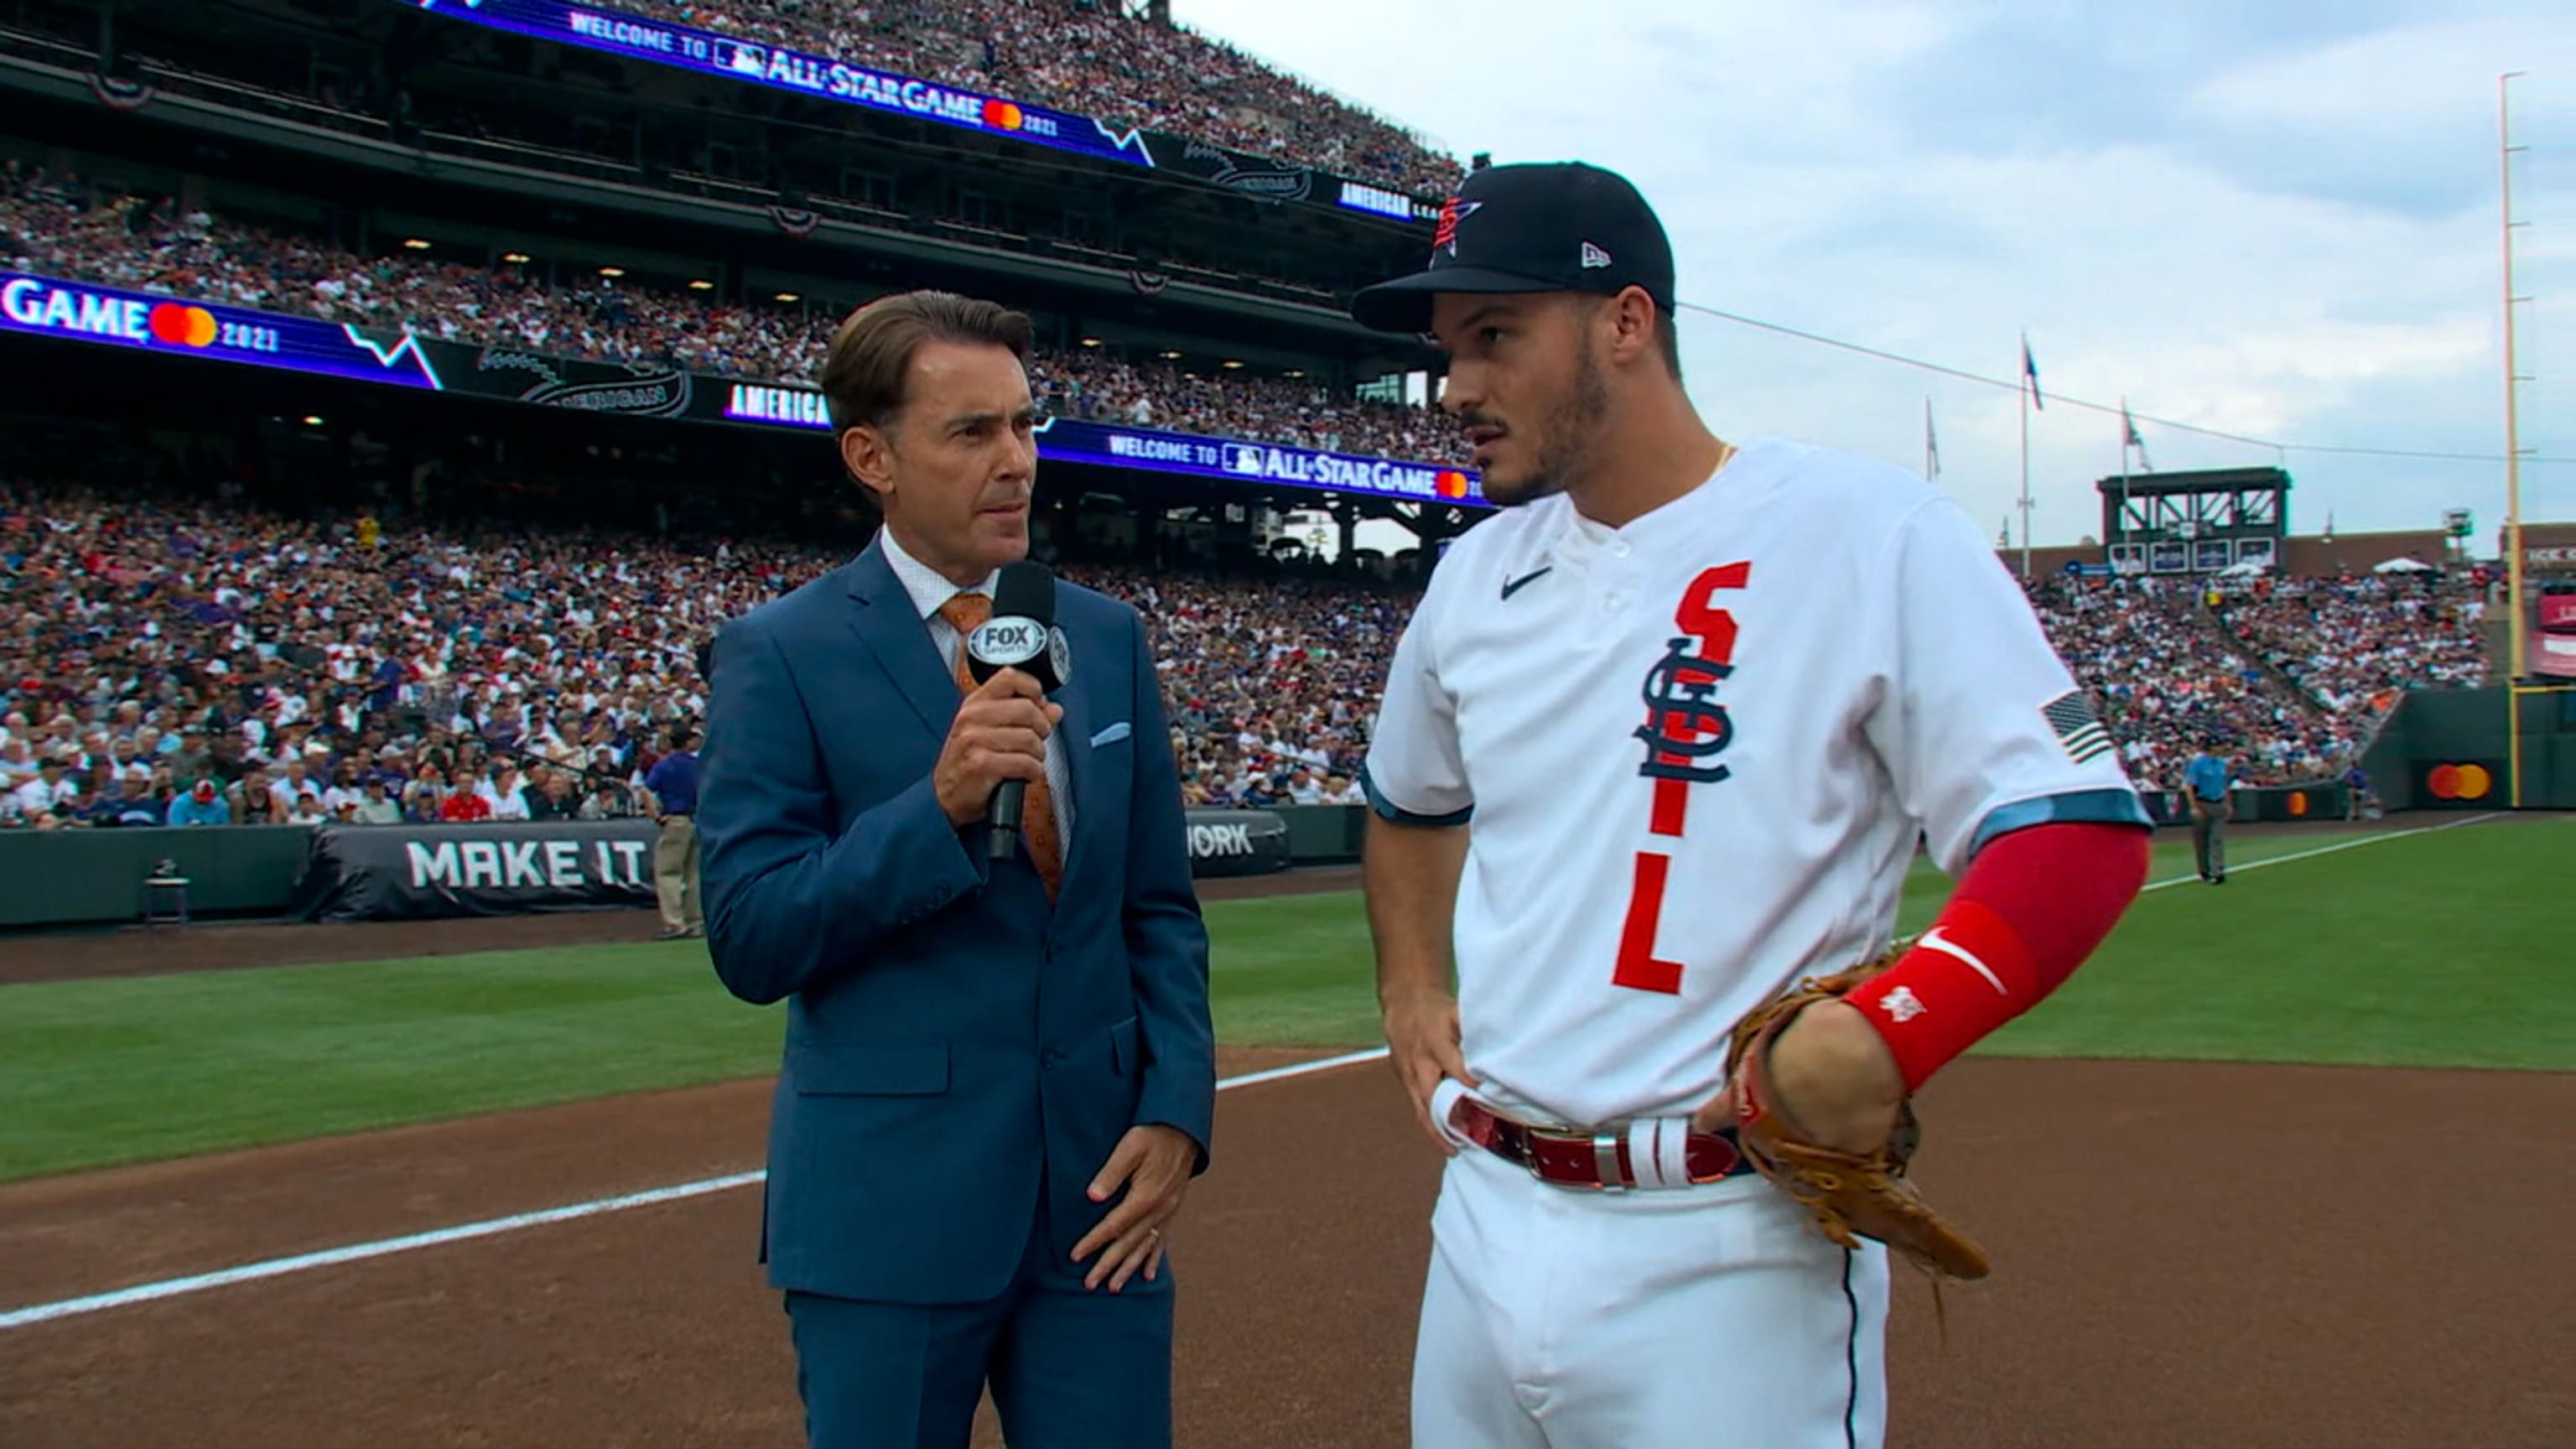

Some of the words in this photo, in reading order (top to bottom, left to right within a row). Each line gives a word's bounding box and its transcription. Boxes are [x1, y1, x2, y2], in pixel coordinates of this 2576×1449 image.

[570, 12, 673, 52] WELCOME
[681, 36, 707, 60] TO
[1024, 115, 1058, 137] 2021
[1342, 182, 1410, 217] AMERICAN
[1413, 204, 1442, 221] LEA
[2, 278, 151, 341] GAME
[222, 322, 279, 352] 2021
[731, 384, 831, 424] AMERICA
[1109, 435, 1191, 462] WELCOME
[1196, 446, 1217, 465] TO
[1372, 462, 1436, 497] GAME
[985, 625, 1029, 647] FOX
[406, 841, 584, 888] MAKE
[598, 841, 647, 886] IT
